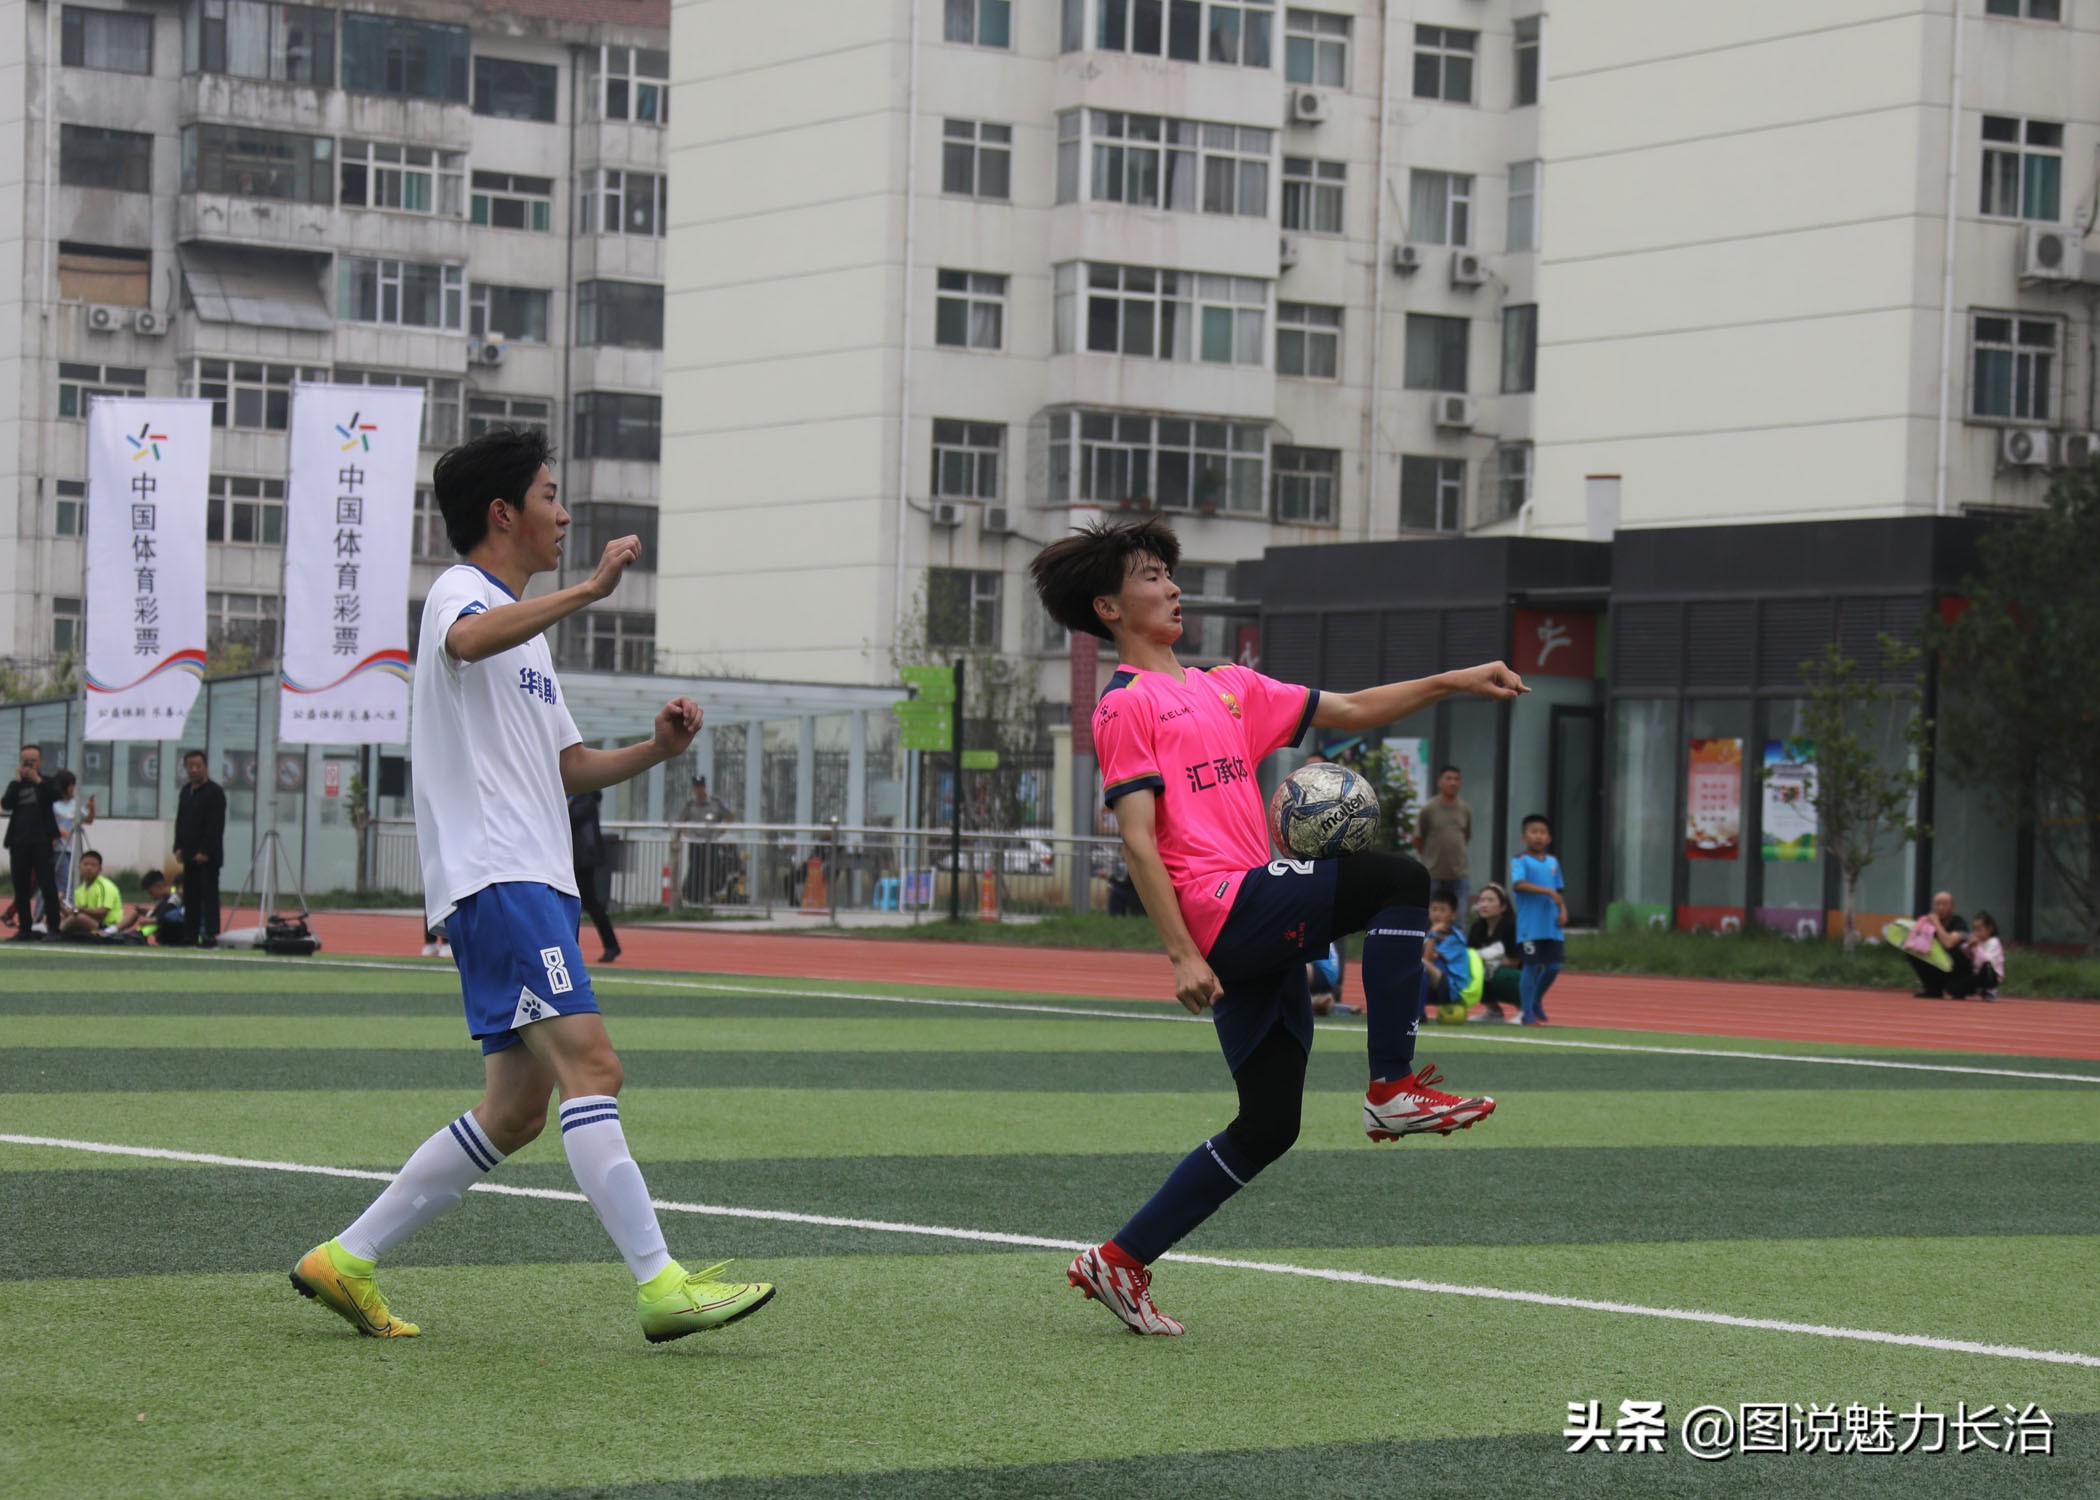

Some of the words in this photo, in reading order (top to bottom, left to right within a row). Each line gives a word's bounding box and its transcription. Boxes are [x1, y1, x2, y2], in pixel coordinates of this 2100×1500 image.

[131, 472, 160, 656] 中国体育彩票
[332, 464, 364, 656] 中国体育彩票
[1159, 706, 1195, 722] KELM
[1185, 755, 1249, 793] 汇承体
[1320, 793, 1366, 833] molten
[540, 946, 574, 995] 8
